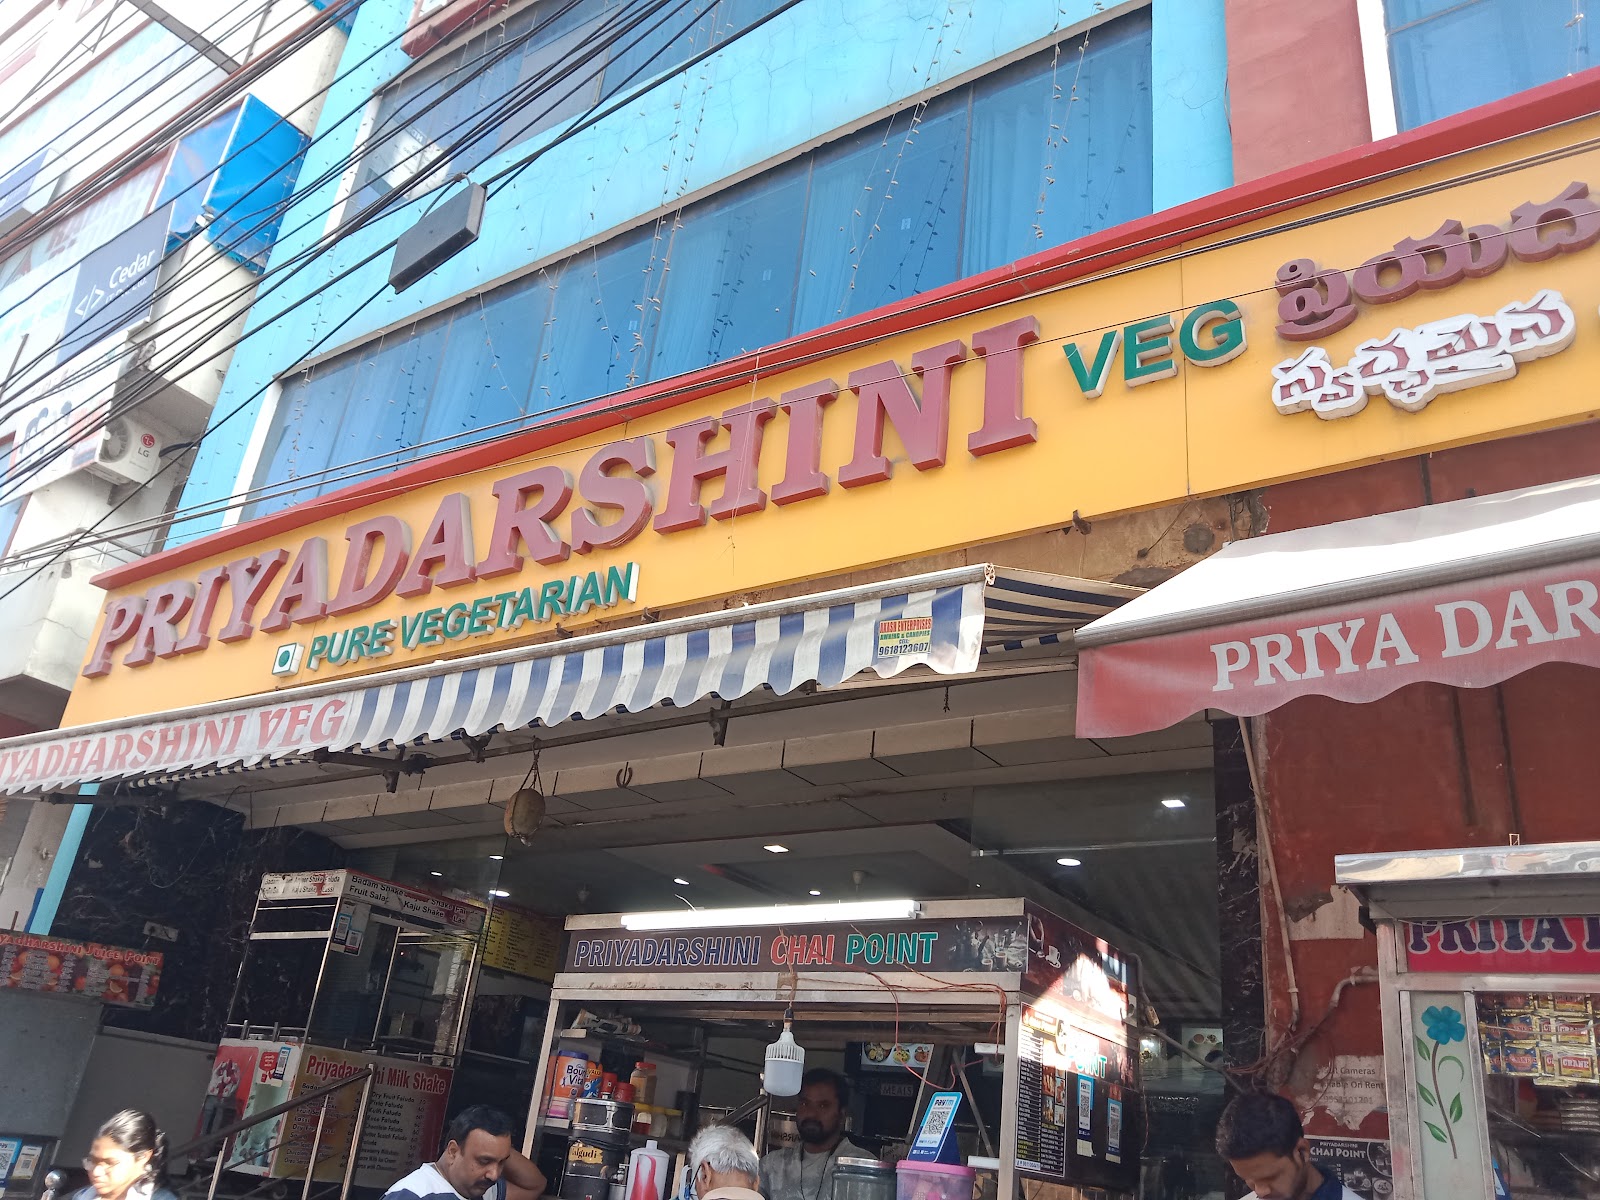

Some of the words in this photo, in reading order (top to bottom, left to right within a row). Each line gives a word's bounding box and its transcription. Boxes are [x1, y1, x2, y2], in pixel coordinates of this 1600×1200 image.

[108, 249, 156, 289] Cedar
[1062, 298, 1248, 399] VEG
[137, 447, 151, 458] LG
[82, 315, 1041, 679] PRIYADARSHINI
[306, 617, 398, 671] PURE
[400, 561, 640, 650] VEGETARIAN
[878, 642, 929, 656] 9618123607
[1210, 612, 1419, 692] PRIYA
[258, 698, 348, 748] VEG
[351, 875, 379, 889] Badam
[349, 885, 368, 897] Fruit
[403, 900, 421, 911] Kaju
[422, 905, 445, 918] Shake
[573, 935, 761, 968] PRIYADARSHINI
[770, 934, 835, 967] CHAI
[845, 931, 939, 965] POINT
[1341, 1067, 1375, 1075] Cameras
[1562, 1058, 1590, 1068] CRANE
[387, 1067, 411, 1089] Milk
[413, 1072, 446, 1095] Shake
[1351, 1081, 1363, 1089] On
[1365, 1082, 1384, 1090] Rent
[1310, 1146, 1334, 1157] CHAI
[1336, 1148, 1366, 1159] POINT
